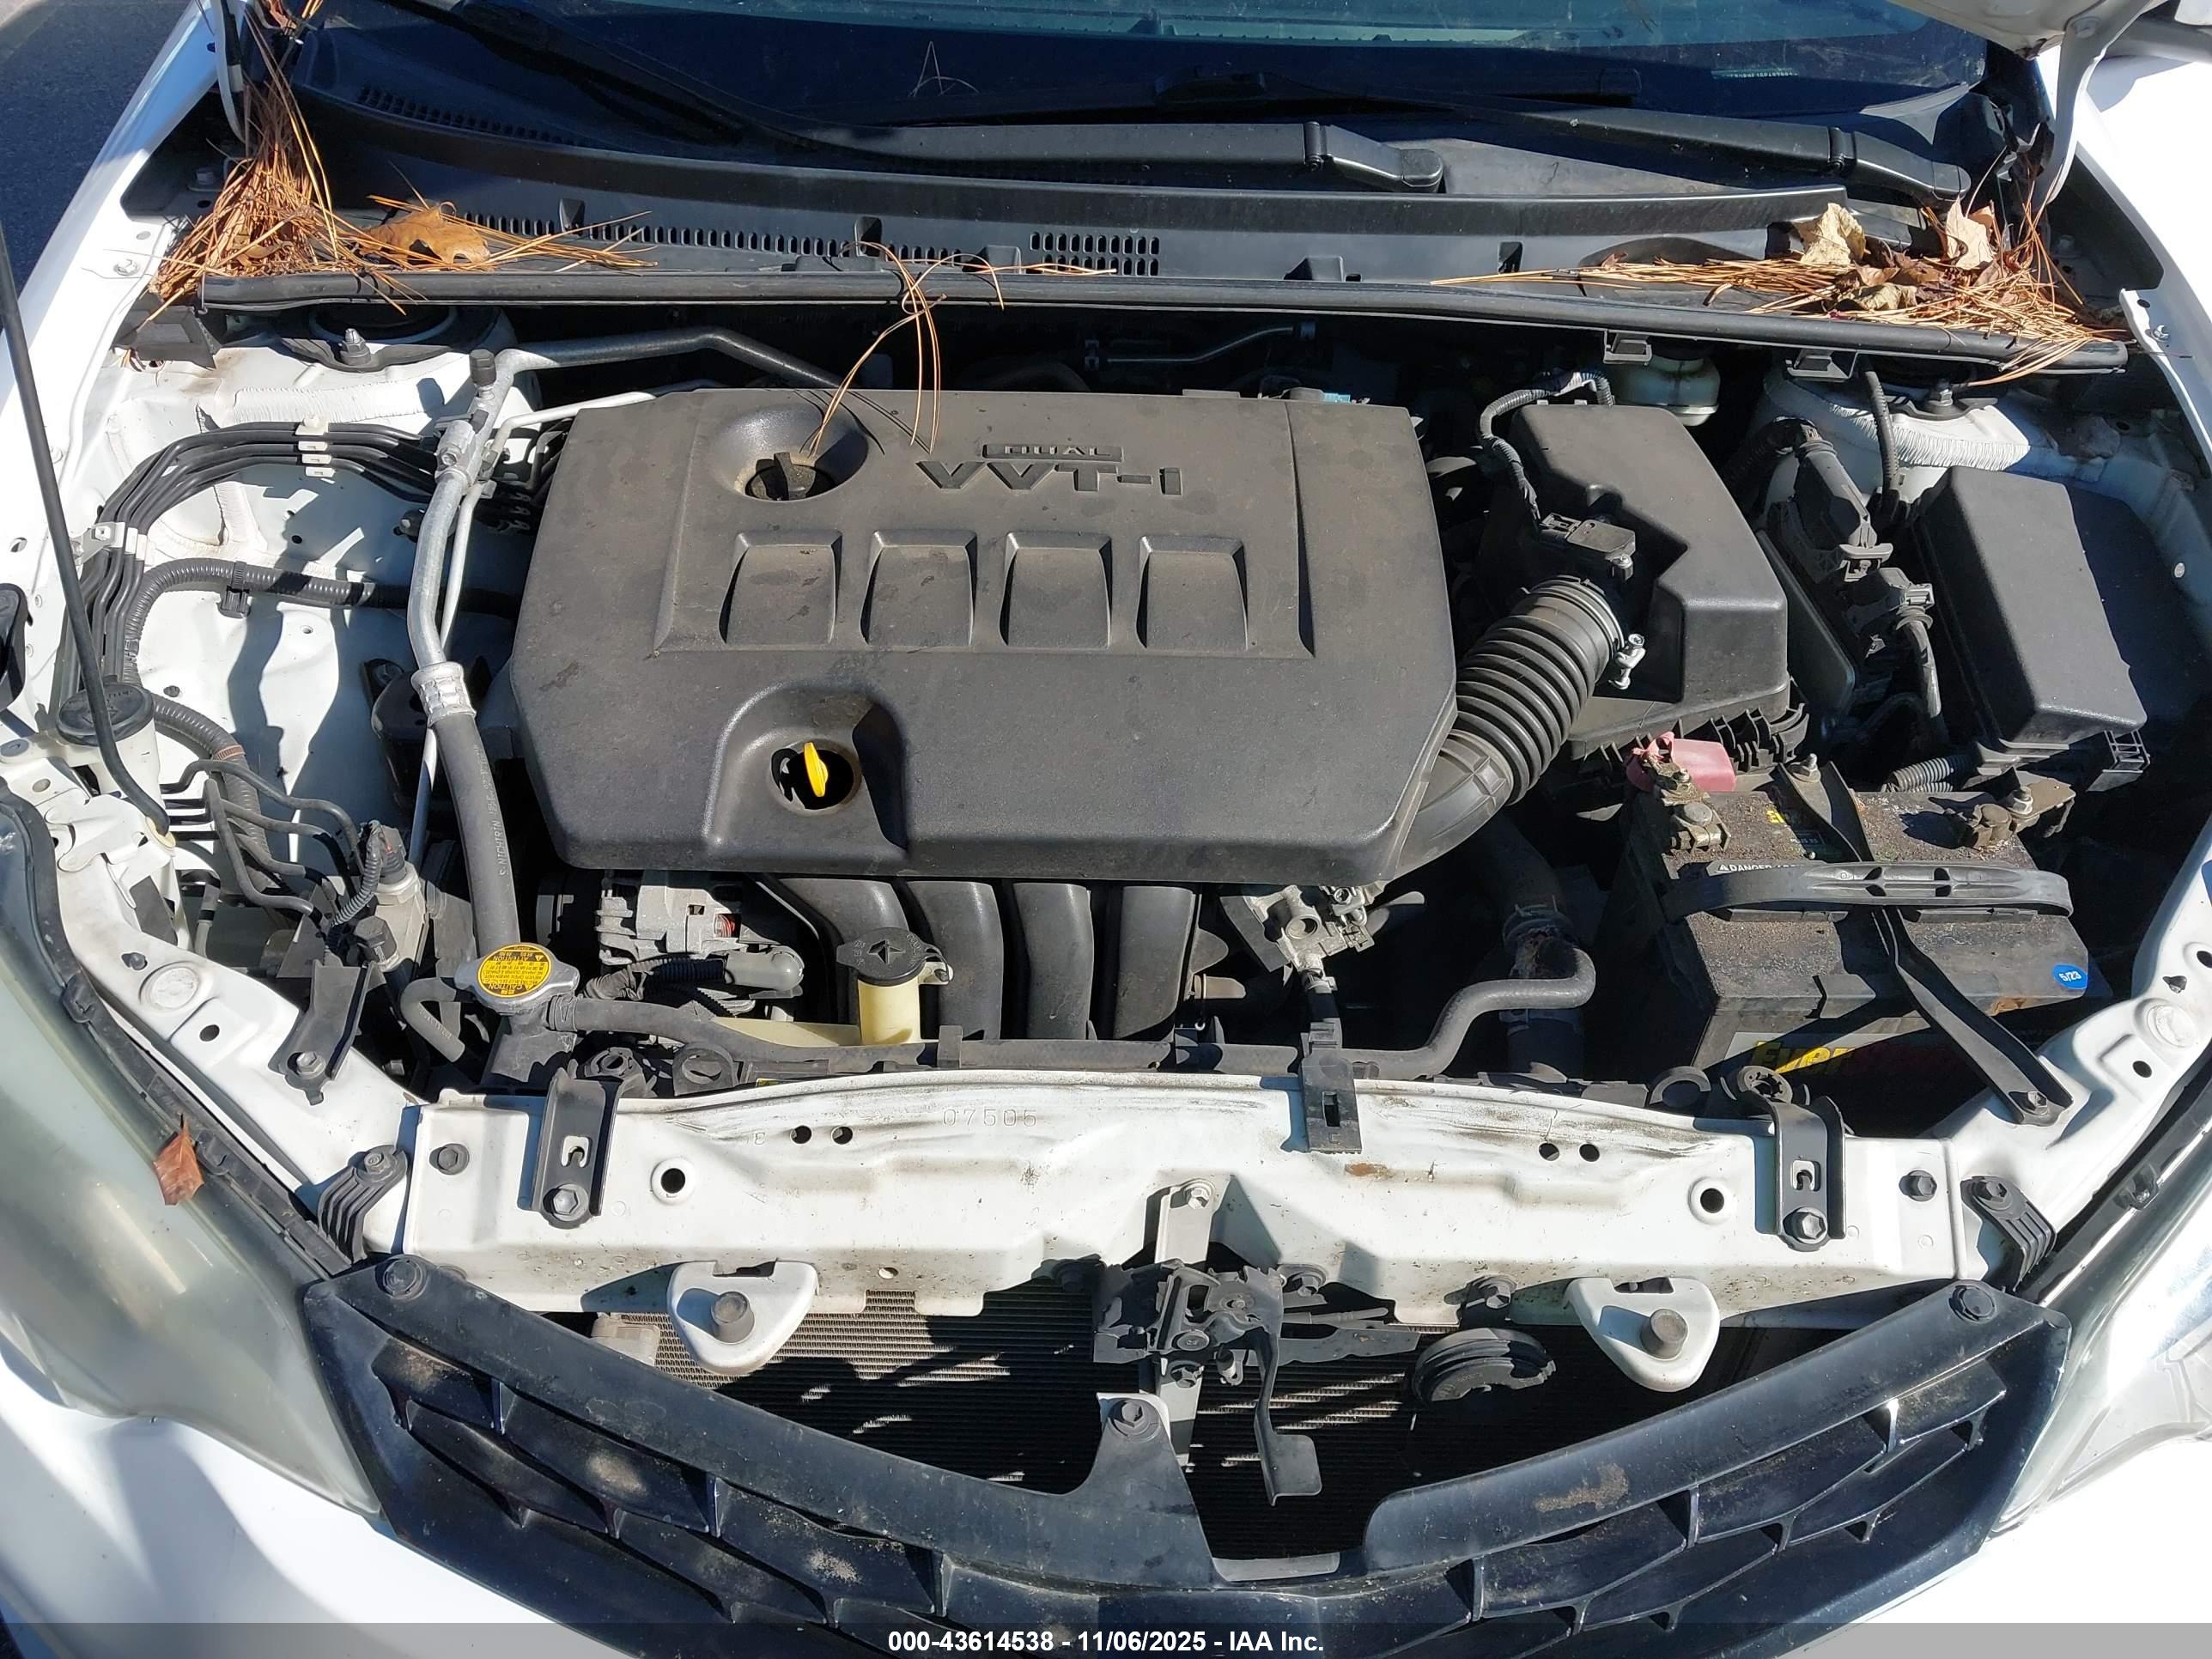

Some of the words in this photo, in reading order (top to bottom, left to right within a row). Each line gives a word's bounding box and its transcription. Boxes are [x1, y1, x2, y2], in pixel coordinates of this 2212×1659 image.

[1004, 445, 1111, 456] DUAL
[2058, 970, 2082, 981] 5/23
[942, 1107, 1037, 1127] 07505
